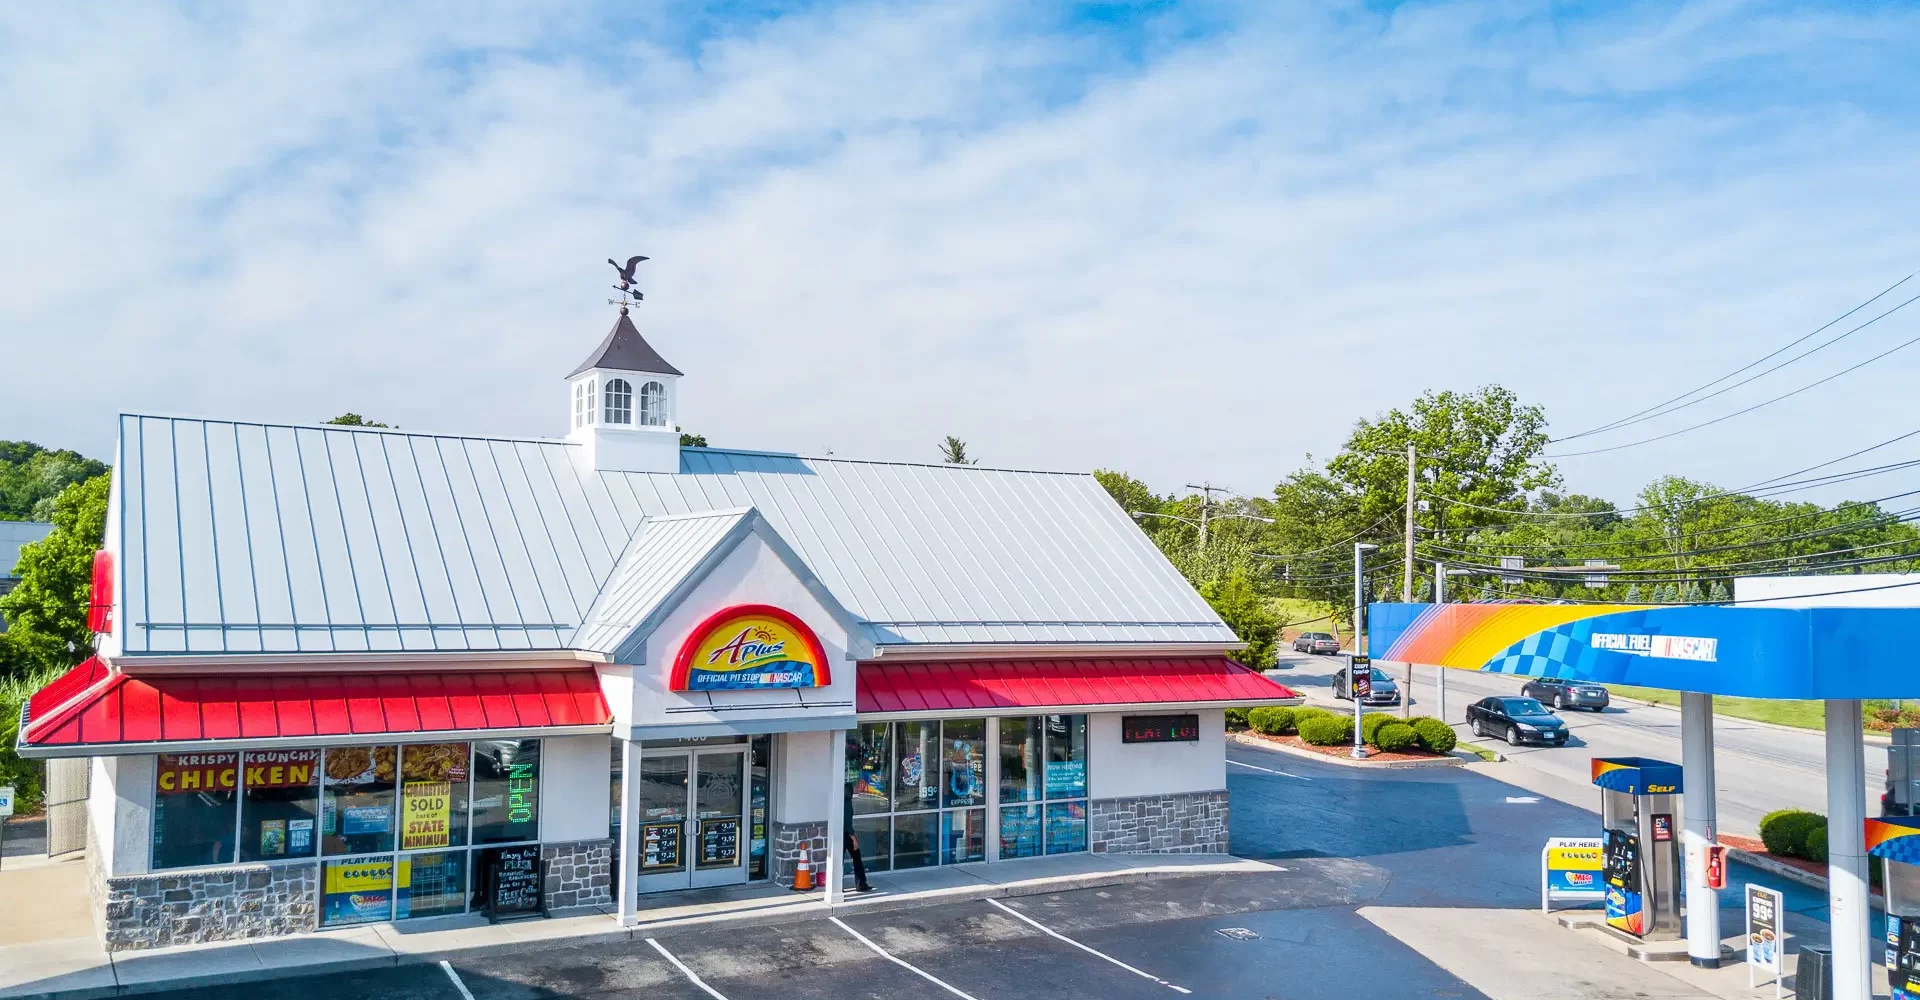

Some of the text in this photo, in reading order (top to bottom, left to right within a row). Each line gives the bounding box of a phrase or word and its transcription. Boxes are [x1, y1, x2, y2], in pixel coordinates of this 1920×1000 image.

[1591, 633, 1651, 650] OFFICIAL FUEL
[1669, 637, 1718, 662] NASCAR
[697, 673, 761, 683] OFFICIAL PIT STOP
[773, 672, 803, 683] NASCAR
[178, 750, 318, 766] KRISPY KRUNCHY
[159, 765, 309, 791] CHICKEN
[405, 782, 450, 798] CIGARETTES
[508, 763, 533, 823] OPEN
[410, 798, 443, 811] SOLD
[409, 820, 444, 834] STATE
[404, 834, 447, 848] MINIMUM
[340, 857, 367, 865] PLAY
[1752, 903, 1773, 920] 99¢
